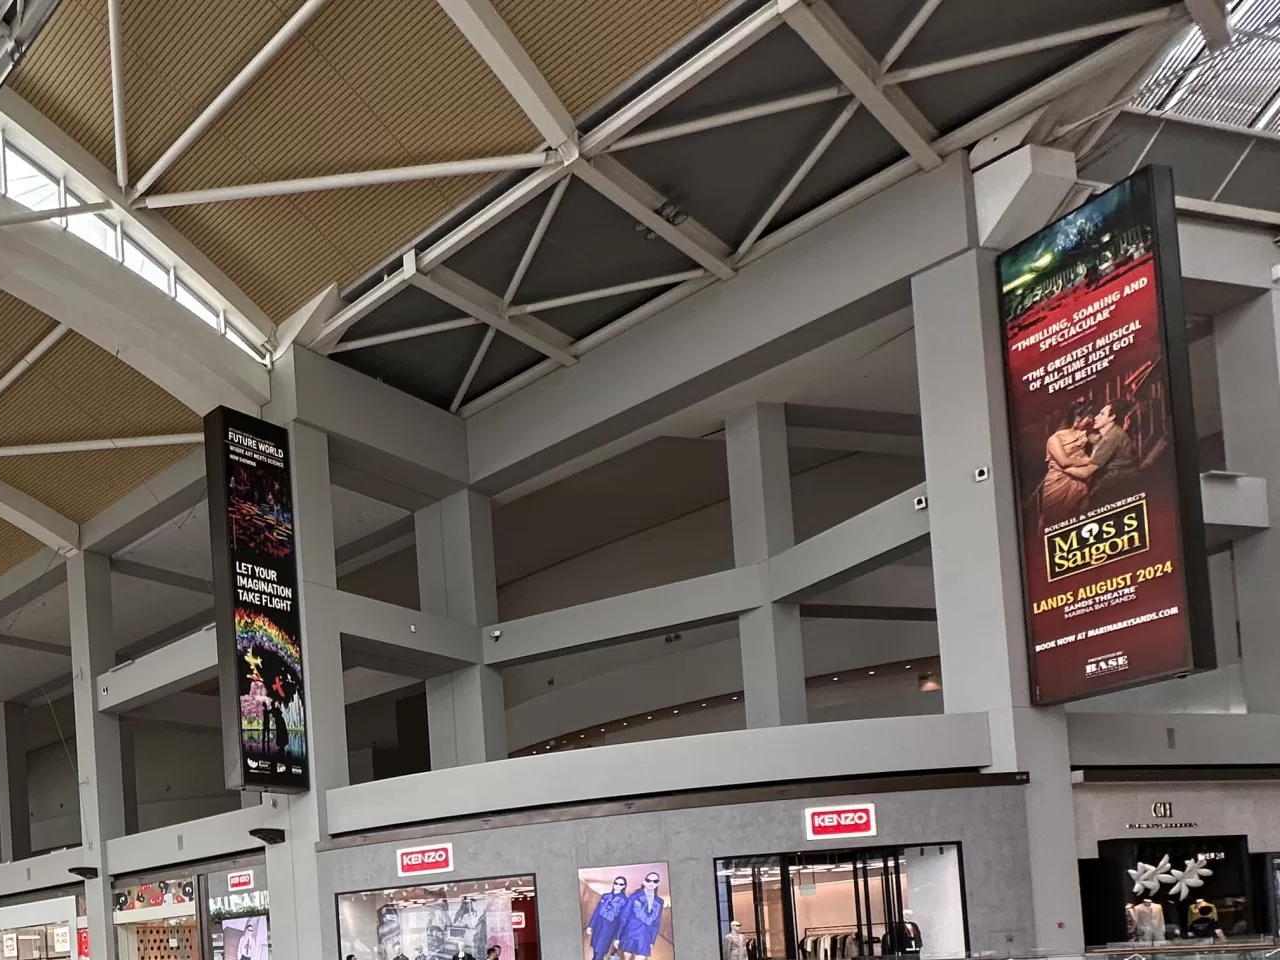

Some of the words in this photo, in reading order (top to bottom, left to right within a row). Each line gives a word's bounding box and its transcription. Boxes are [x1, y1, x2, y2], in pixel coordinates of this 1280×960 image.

[1072, 291, 1121, 323] SOARING
[1123, 277, 1148, 297] AND
[1047, 342, 1093, 371] GREATEST
[1096, 320, 1142, 349] MUSICAL
[1029, 379, 1042, 391] OF
[1044, 357, 1086, 385] ALL-TIME
[1087, 346, 1110, 363] JUST
[1112, 334, 1135, 351] GOT
[1048, 378, 1073, 394] EVEN
[228, 431, 258, 450] FUTURE
[258, 442, 284, 458] WORLD
[1044, 518, 1078, 533] BOUBLIL
[1054, 531, 1142, 572] Saigon
[236, 561, 253, 576] LET
[254, 565, 277, 582] YOUR
[236, 575, 292, 599] IMAGINATION
[1033, 592, 1074, 614] LANDS
[1077, 573, 1133, 600] AUGUST
[1136, 560, 1173, 582] 2024
[237, 589, 261, 605] TAKE
[262, 595, 292, 612] FLIGHT
[1064, 597, 1094, 613] SANDS
[1064, 606, 1094, 619] MARINA
[1094, 601, 1109, 611] BAY
[1110, 594, 1136, 606] SANDS
[1035, 640, 1056, 652] BOOK
[1056, 635, 1076, 647] NOW
[1076, 631, 1087, 641] AT
[1087, 607, 1179, 638] MARINABAYSANDS.COM
[1085, 655, 1128, 674] BASE
[814, 812, 868, 827] KENZO
[1151, 802, 1173, 818] CH
[403, 851, 446, 866] KENZO
